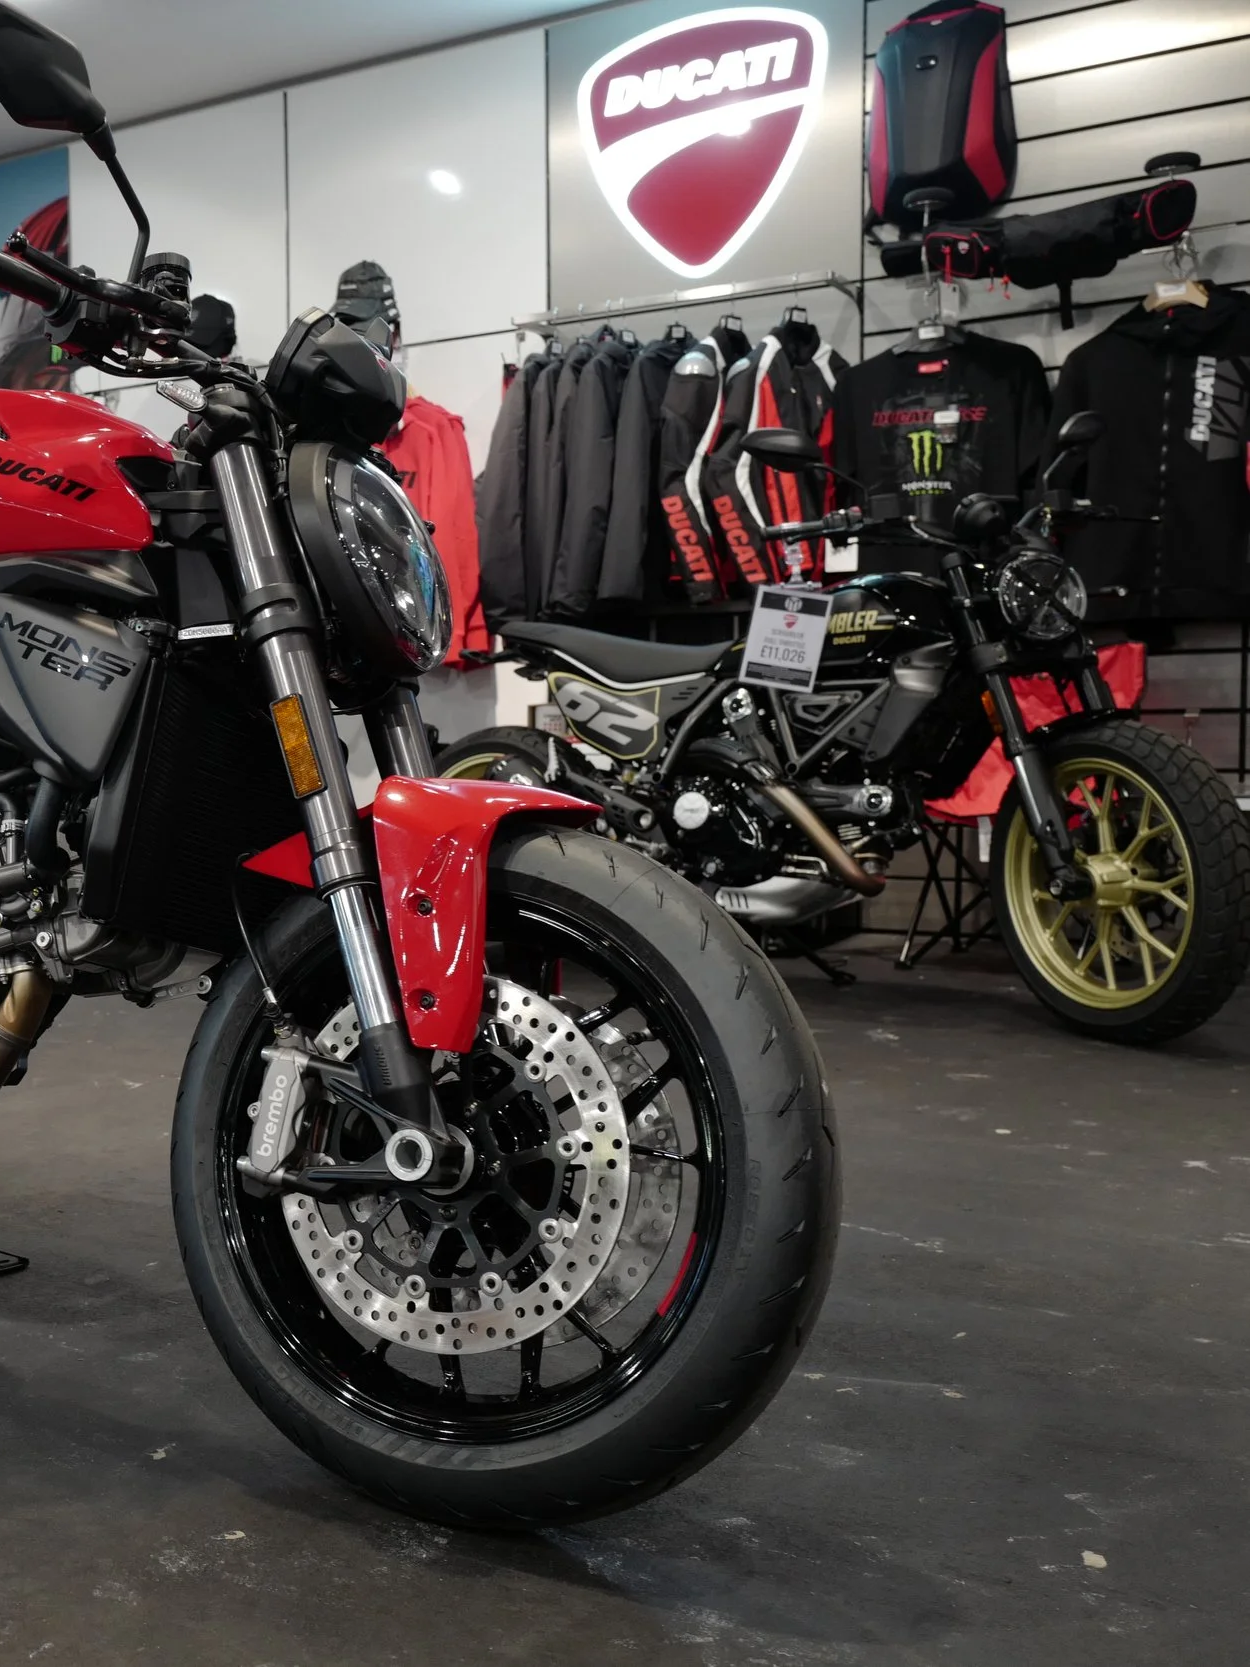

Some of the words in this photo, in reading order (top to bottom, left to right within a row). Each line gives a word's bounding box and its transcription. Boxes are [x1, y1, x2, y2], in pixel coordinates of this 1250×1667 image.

[603, 37, 798, 118] DUCATI
[1190, 355, 1217, 442] DUCATI
[661, 495, 714, 582] DUCATI
[713, 494, 767, 583] DUCATI
[0, 612, 137, 678] MONS
[17, 639, 115, 692] TER
[760, 645, 806, 664] £11,026
[833, 634, 866, 645] DUCATI
[559, 681, 659, 746] 62
[256, 1075, 288, 1157] brembo
